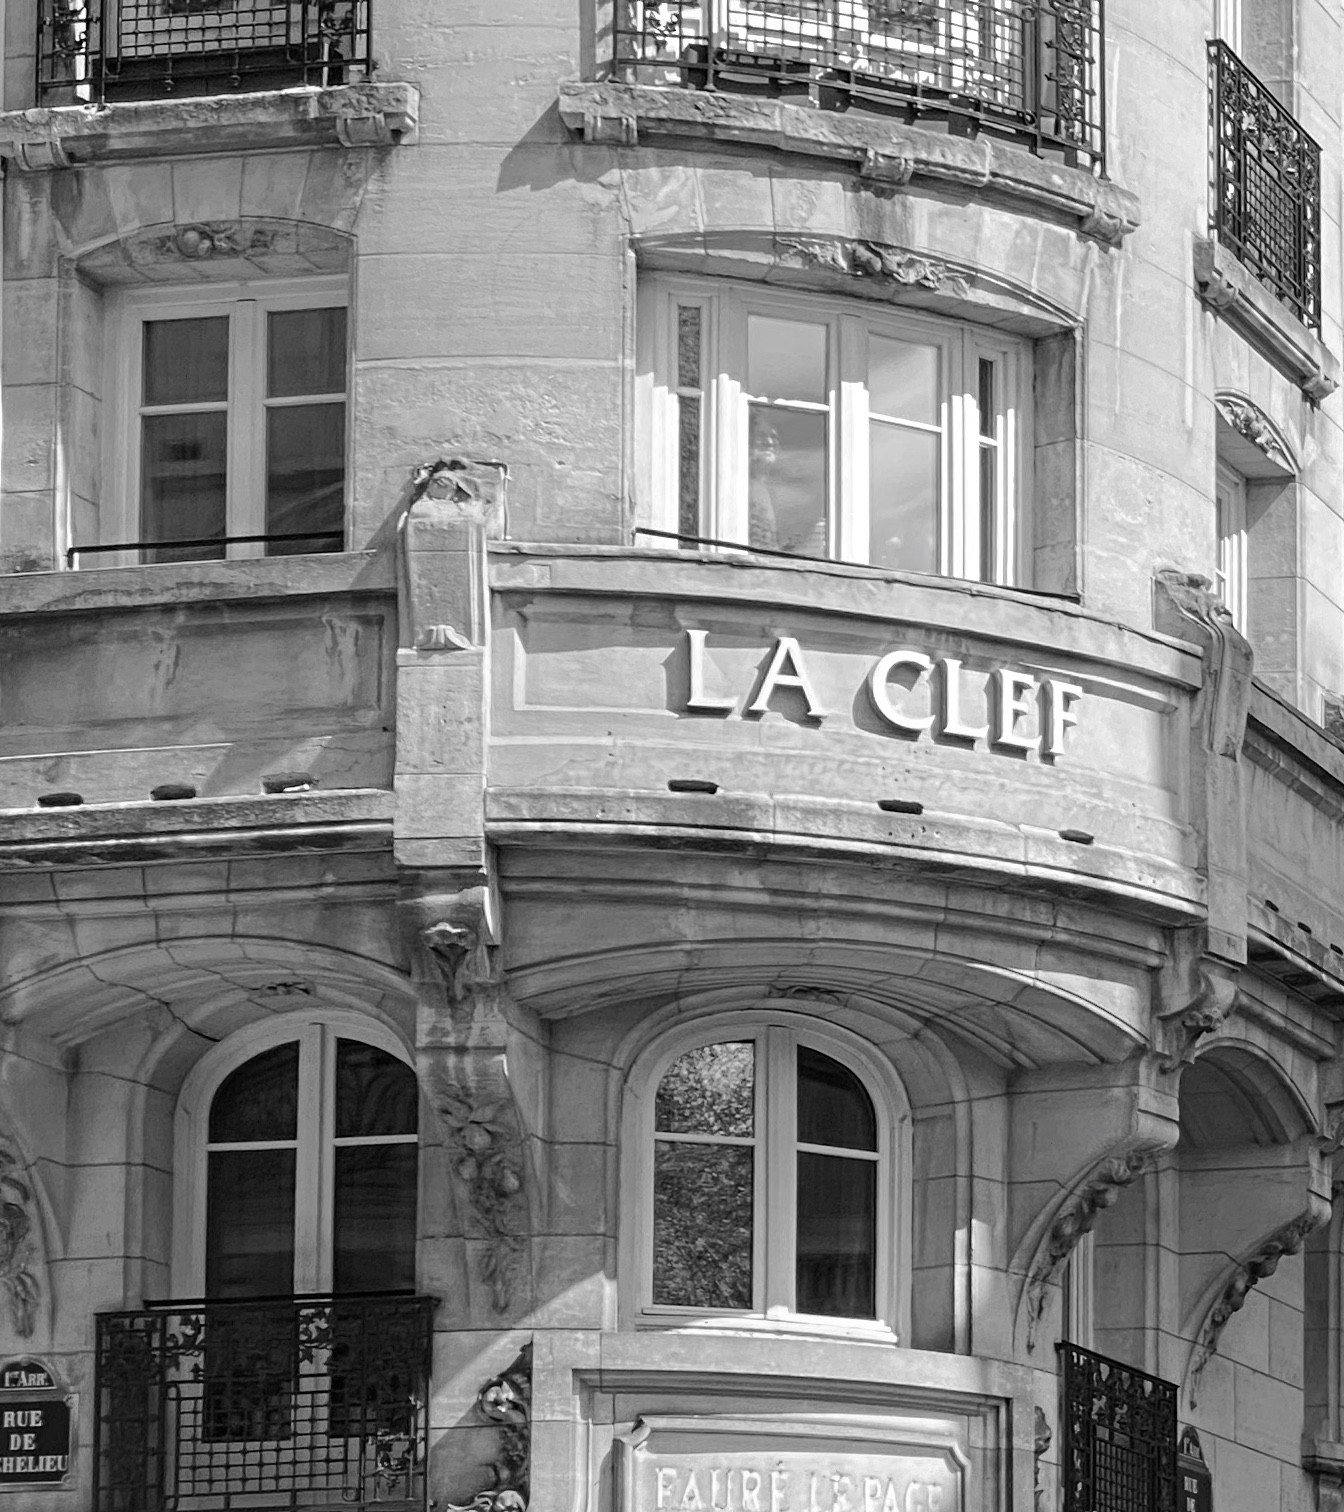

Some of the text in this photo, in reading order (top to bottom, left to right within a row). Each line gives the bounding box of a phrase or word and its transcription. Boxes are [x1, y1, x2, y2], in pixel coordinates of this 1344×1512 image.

[685, 629, 1083, 756] LA CLEF
[3, 1410, 43, 1428] RUE
[10, 1433, 36, 1451] DE
[0, 1455, 68, 1473] HELIEU
